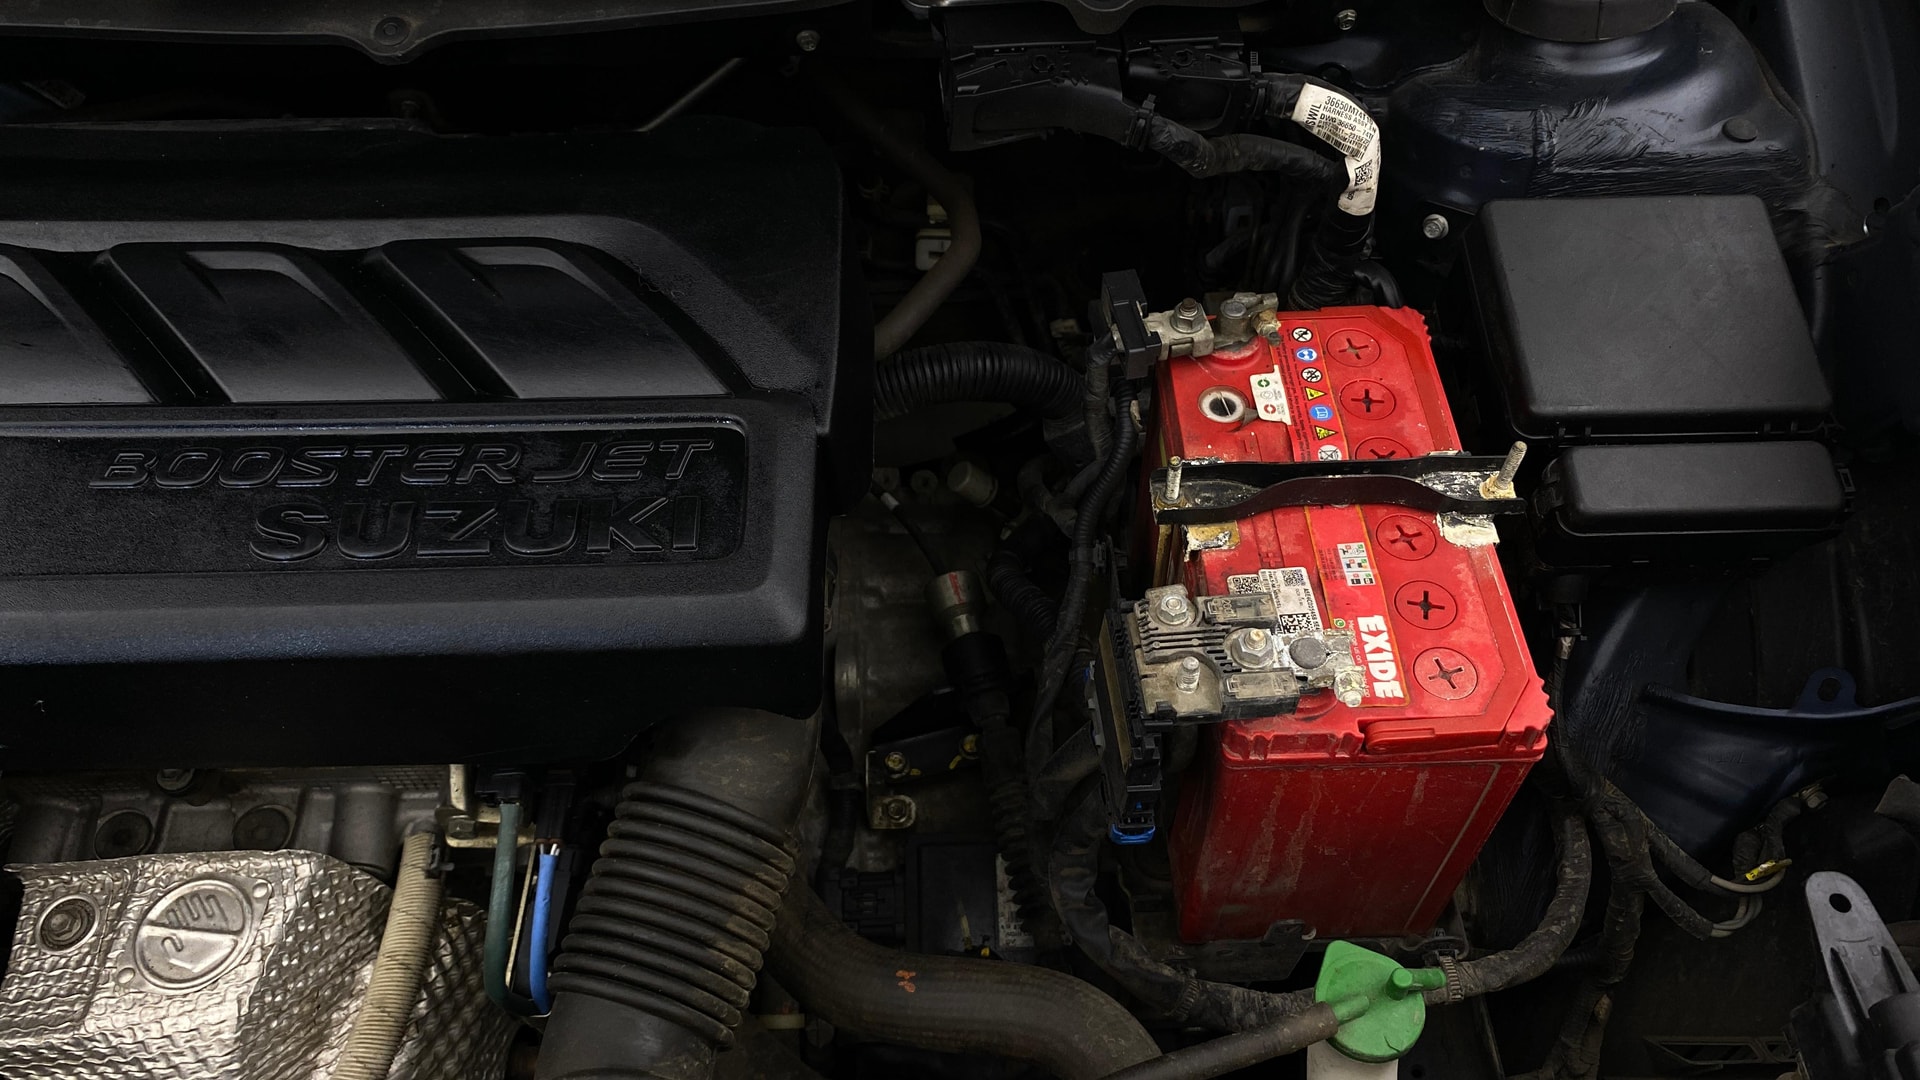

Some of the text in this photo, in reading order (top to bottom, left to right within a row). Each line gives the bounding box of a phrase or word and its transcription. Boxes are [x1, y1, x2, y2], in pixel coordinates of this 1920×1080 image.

[1305, 104, 1322, 126] SWIL
[1323, 105, 1352, 121] HARNESS
[249, 498, 701, 563] SUZUKI
[1357, 615, 1404, 698] EXIDE
